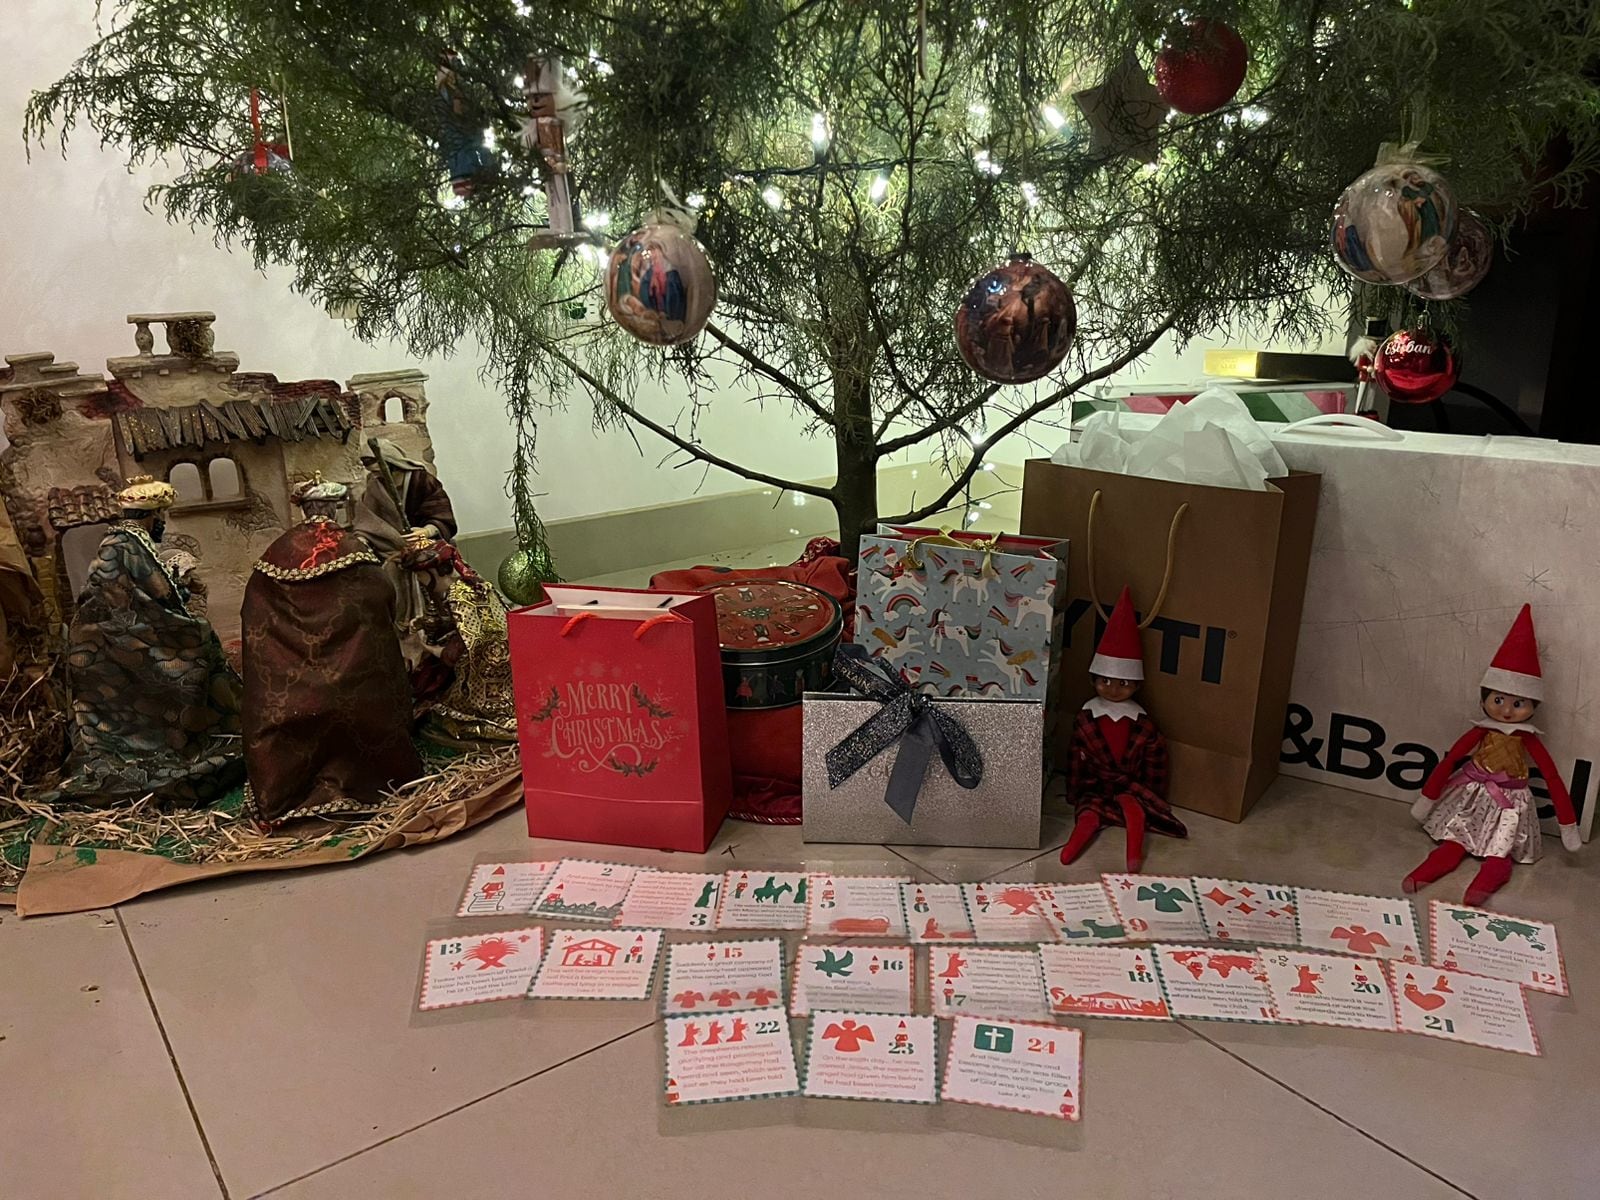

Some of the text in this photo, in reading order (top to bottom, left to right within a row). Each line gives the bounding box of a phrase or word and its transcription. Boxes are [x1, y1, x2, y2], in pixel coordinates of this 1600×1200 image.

[558, 681, 636, 718] MERRY
[550, 714, 666, 760] CHRISTMAS
[600, 867, 613, 877] 2
[1265, 889, 1293, 902] 10
[820, 896, 836, 909] 5
[913, 901, 930, 913] 6
[978, 902, 990, 913] 7
[689, 913, 708, 926] 3
[1128, 918, 1148, 932] 9
[1382, 913, 1403, 926] 11
[440, 942, 462, 955] 13
[724, 947, 743, 958] 15
[883, 960, 904, 971] 16
[1531, 970, 1557, 986] 12
[1351, 982, 1381, 994] 20
[755, 1020, 780, 1034] 22
[1424, 1015, 1455, 1033] 21
[888, 1042, 914, 1055] 23
[1027, 1037, 1056, 1054] 24
